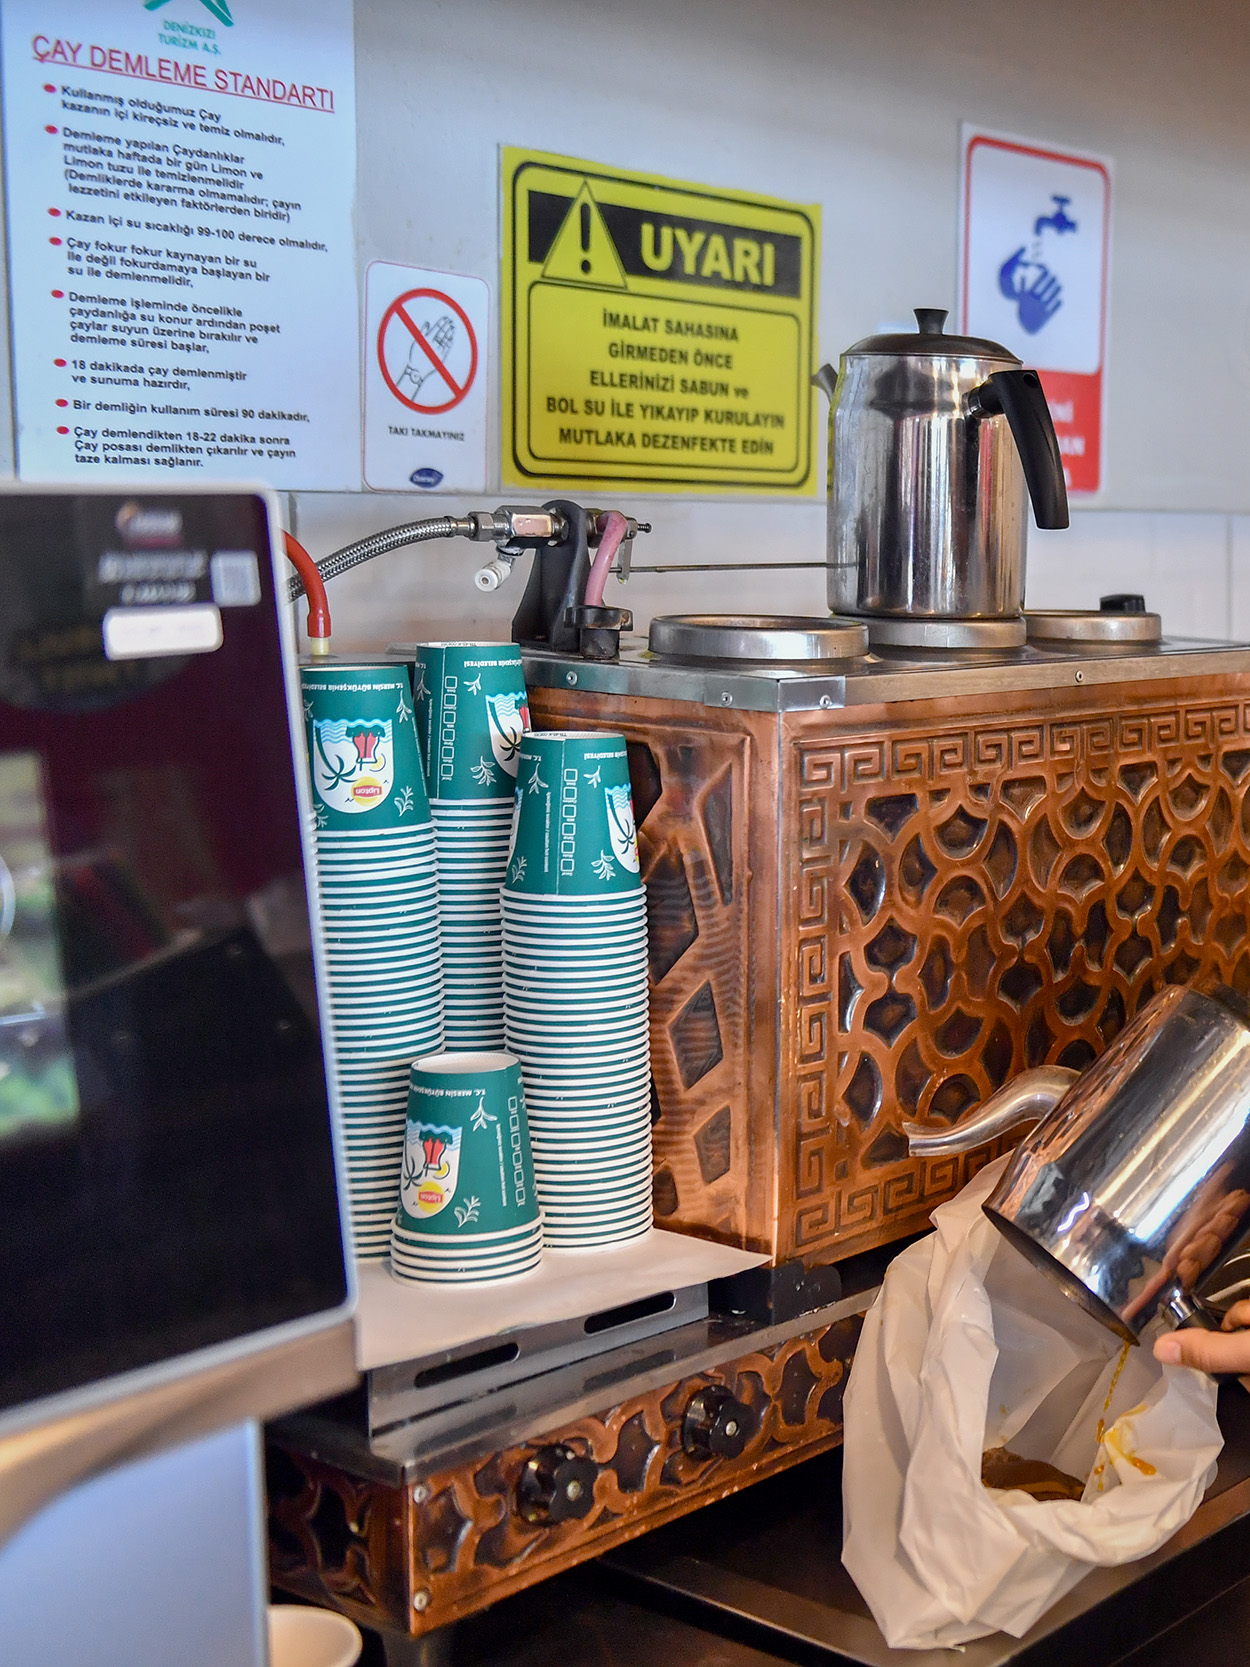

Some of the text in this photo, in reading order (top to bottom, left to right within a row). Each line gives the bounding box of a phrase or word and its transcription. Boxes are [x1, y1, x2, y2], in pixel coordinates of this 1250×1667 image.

[158, 32, 198, 50] TURİZM
[164, 19, 216, 39] DENİZKIZI
[32, 35, 334, 110] ÇAY DEMLEME STANDARTI
[62, 84, 221, 124] Kullanmış olduğumuz Çay
[62, 97, 111, 116] kazanın
[132, 109, 179, 127] kireçsiz
[182, 121, 196, 130] ve
[199, 121, 231, 136] temiz
[63, 126, 244, 164] Demleme yapılan Çaydanlıklar
[63, 143, 114, 157] mutlaka
[117, 148, 163, 165] haftada
[166, 155, 182, 168] bir
[185, 159, 208, 172] gün
[250, 171, 263, 180] ve
[107, 160, 134, 174] tuzu
[69, 181, 120, 199] lezzetini
[181, 197, 251, 216] faktörlerden
[146, 179, 195, 196] kararma
[272, 199, 301, 211] çayın
[66, 209, 105, 224] Kazan
[126, 219, 142, 228] su
[197, 225, 235, 240] 99-100
[238, 230, 276, 245] derece
[67, 235, 257, 269] Çay fokur fokur kaynayan bir su
[641, 222, 775, 287] UYARI
[68, 267, 83, 276] su
[86, 252, 117, 267] değil
[120, 256, 198, 276] fokurdamaya
[255, 271, 269, 282] bir
[69, 291, 243, 317] Demleme işleminde öncelikle
[69, 307, 280, 334] çaydanlığa su konur ardından poşet
[70, 320, 108, 333] çaylar
[111, 324, 149, 336] suyun
[152, 325, 196, 339] üzerine
[245, 335, 258, 344] ve
[602, 308, 738, 342] İMALAT SAHASINA
[70, 331, 127, 346] demleme
[130, 337, 168, 349] süresi
[608, 343, 732, 369] GİRMEDEN ÖNCE
[72, 375, 87, 383] ve
[90, 376, 140, 387] sunuma
[73, 359, 246, 383] 18 dakikada çay demlenmiştir
[589, 369, 749, 399] ELLERİNİZİ SABUN ve
[73, 399, 91, 410] Bir
[94, 400, 148, 415] demliğin
[151, 403, 201, 416] kullanım
[204, 406, 239, 418] süresi
[242, 408, 255, 419] 90
[546, 397, 784, 429] BOL SU İLE YIKAYIP KURULAYIN
[74, 426, 290, 445] Çay demlendikten 18-22 dakika sonra
[559, 427, 774, 454] MUTLAKA DEZENFEKTE EDİN
[74, 439, 99, 453] Çay
[102, 443, 143, 453] posası
[146, 442, 203, 455] demlikten
[252, 449, 264, 457] ve
[267, 450, 296, 460] çayın
[75, 453, 101, 464] taze
[104, 454, 151, 465] kalması
[355, 787, 380, 795] Lipton
